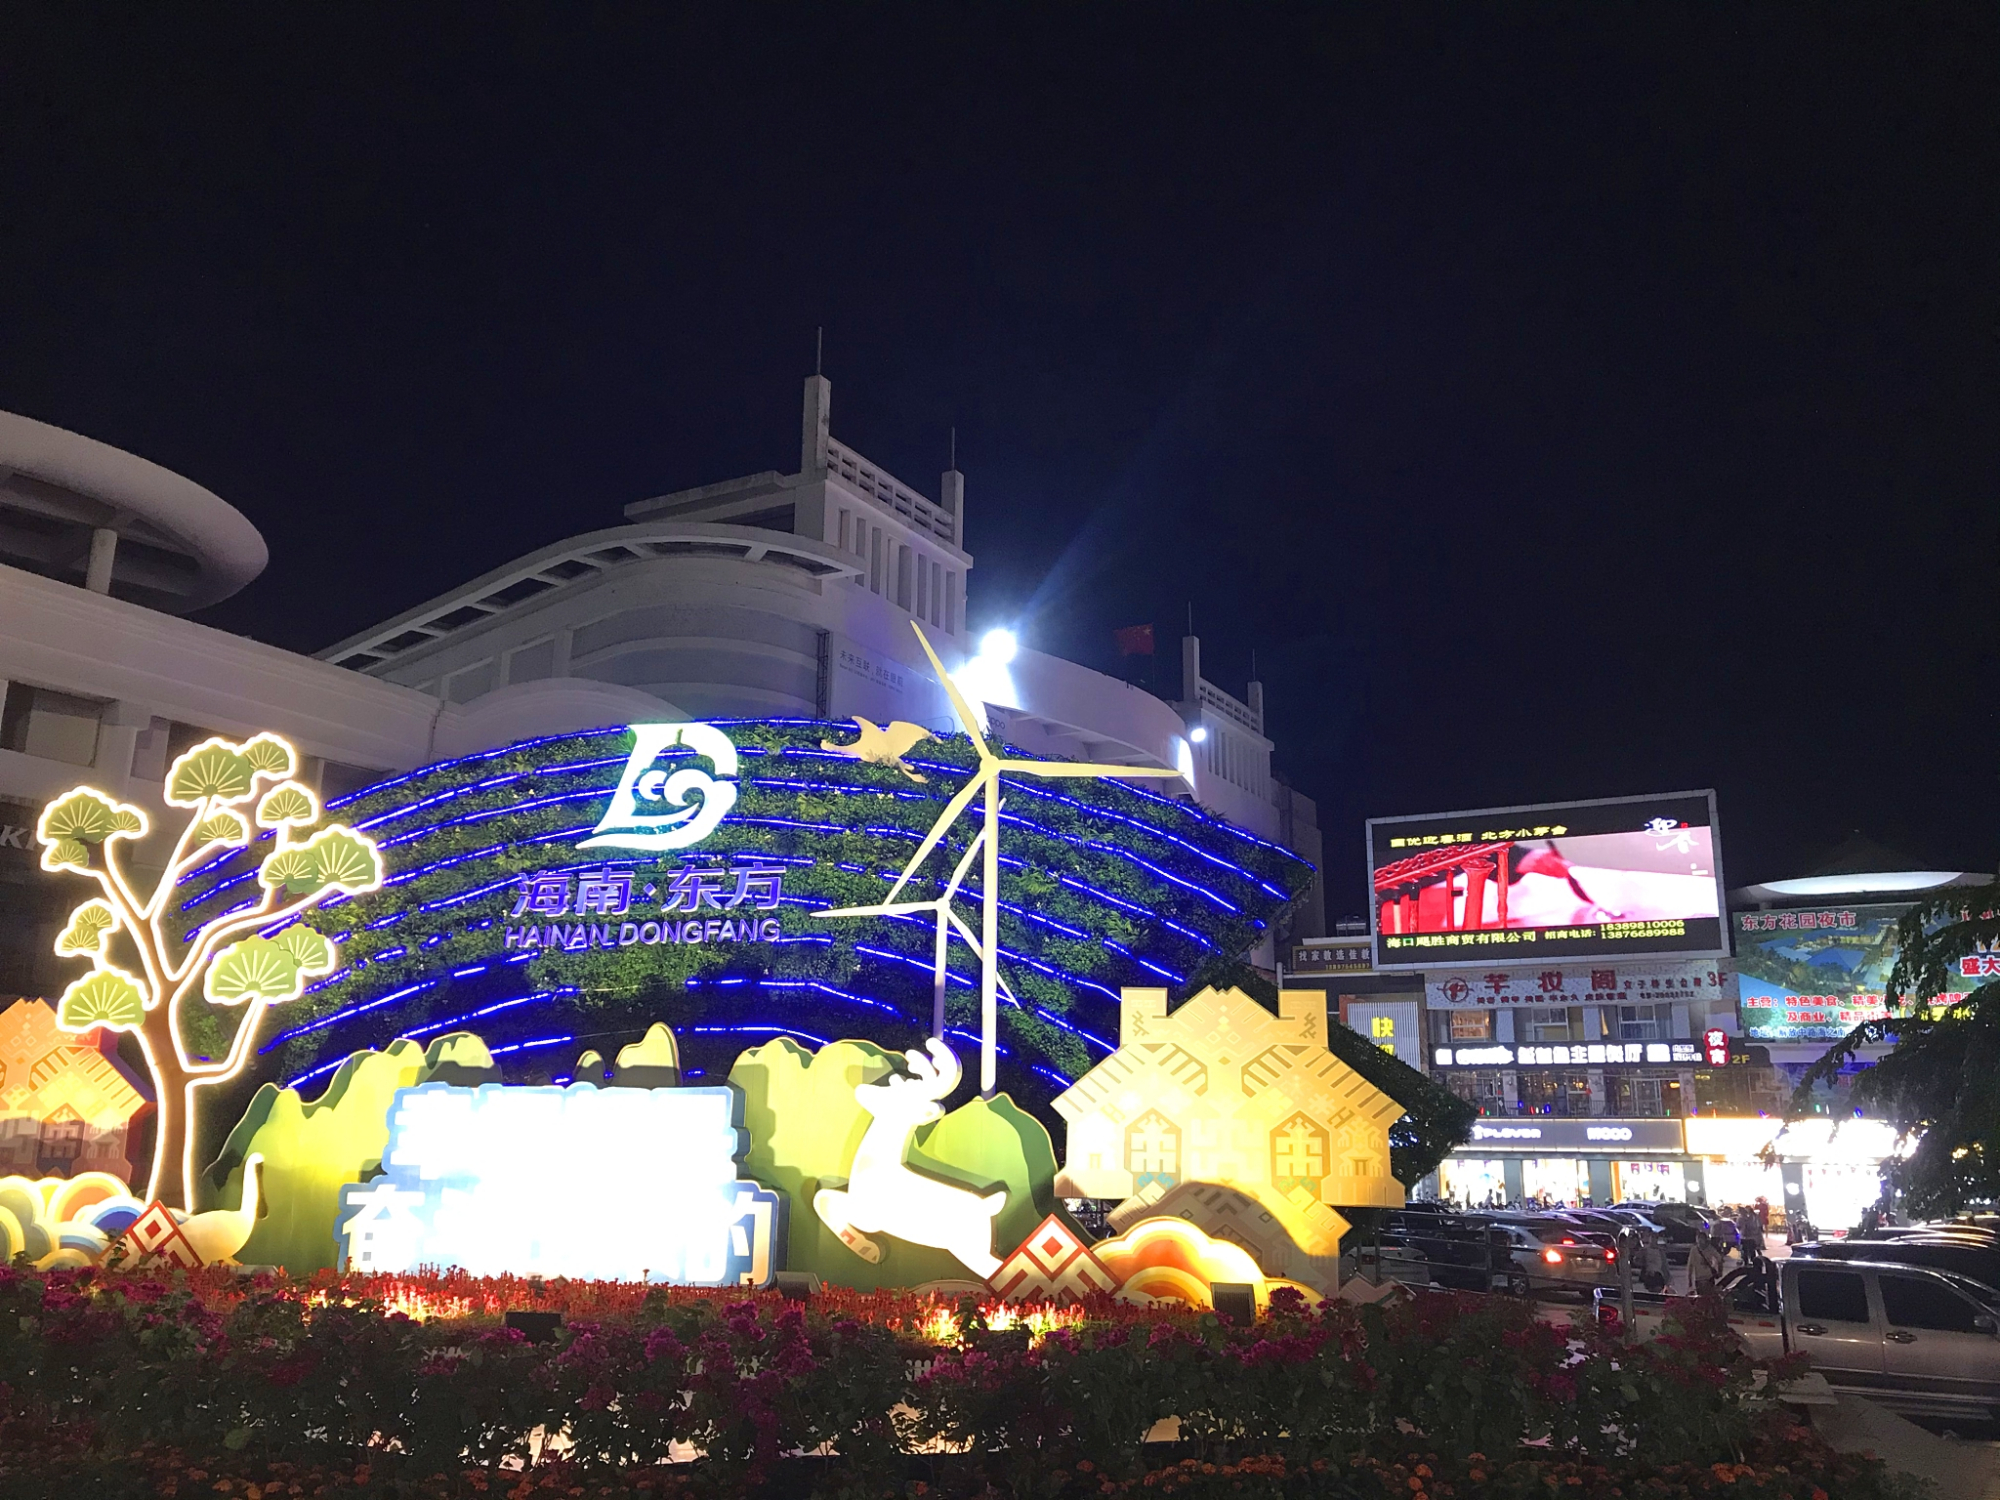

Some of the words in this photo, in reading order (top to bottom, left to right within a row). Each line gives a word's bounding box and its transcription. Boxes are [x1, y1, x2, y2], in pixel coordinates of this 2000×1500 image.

[1600, 920, 1685, 931] 18389810006
[1741, 912, 1857, 931] 东方花园夜市
[504, 922, 610, 948] HAINAN
[619, 919, 781, 945] DONGFANG
[1601, 928, 1686, 939] 13876689988
[1960, 956, 2000, 976] 盛大
[1707, 971, 1729, 988] 3F
[1732, 1054, 1750, 1064] 2F
